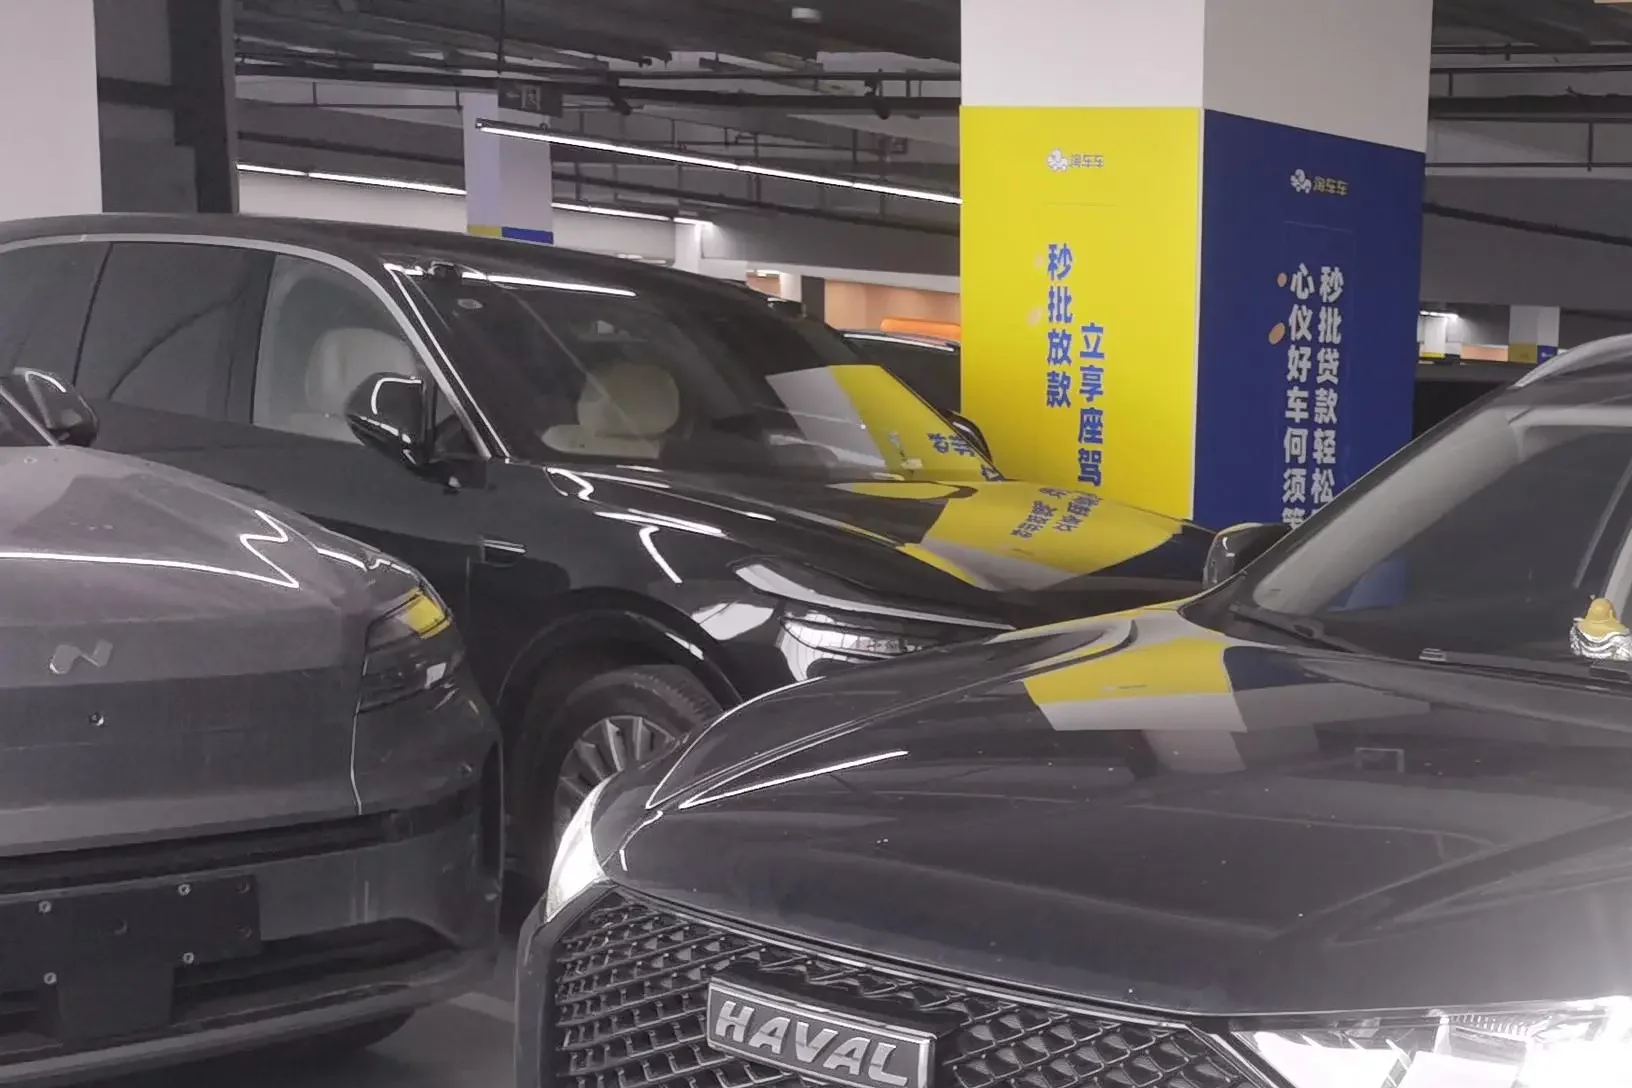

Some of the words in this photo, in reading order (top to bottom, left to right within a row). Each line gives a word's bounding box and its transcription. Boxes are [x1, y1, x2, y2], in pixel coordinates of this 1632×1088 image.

[1046, 243, 1073, 409] 秒批放款
[1077, 322, 1105, 487] 立享座驾
[715, 1000, 908, 1087] HAVAL
